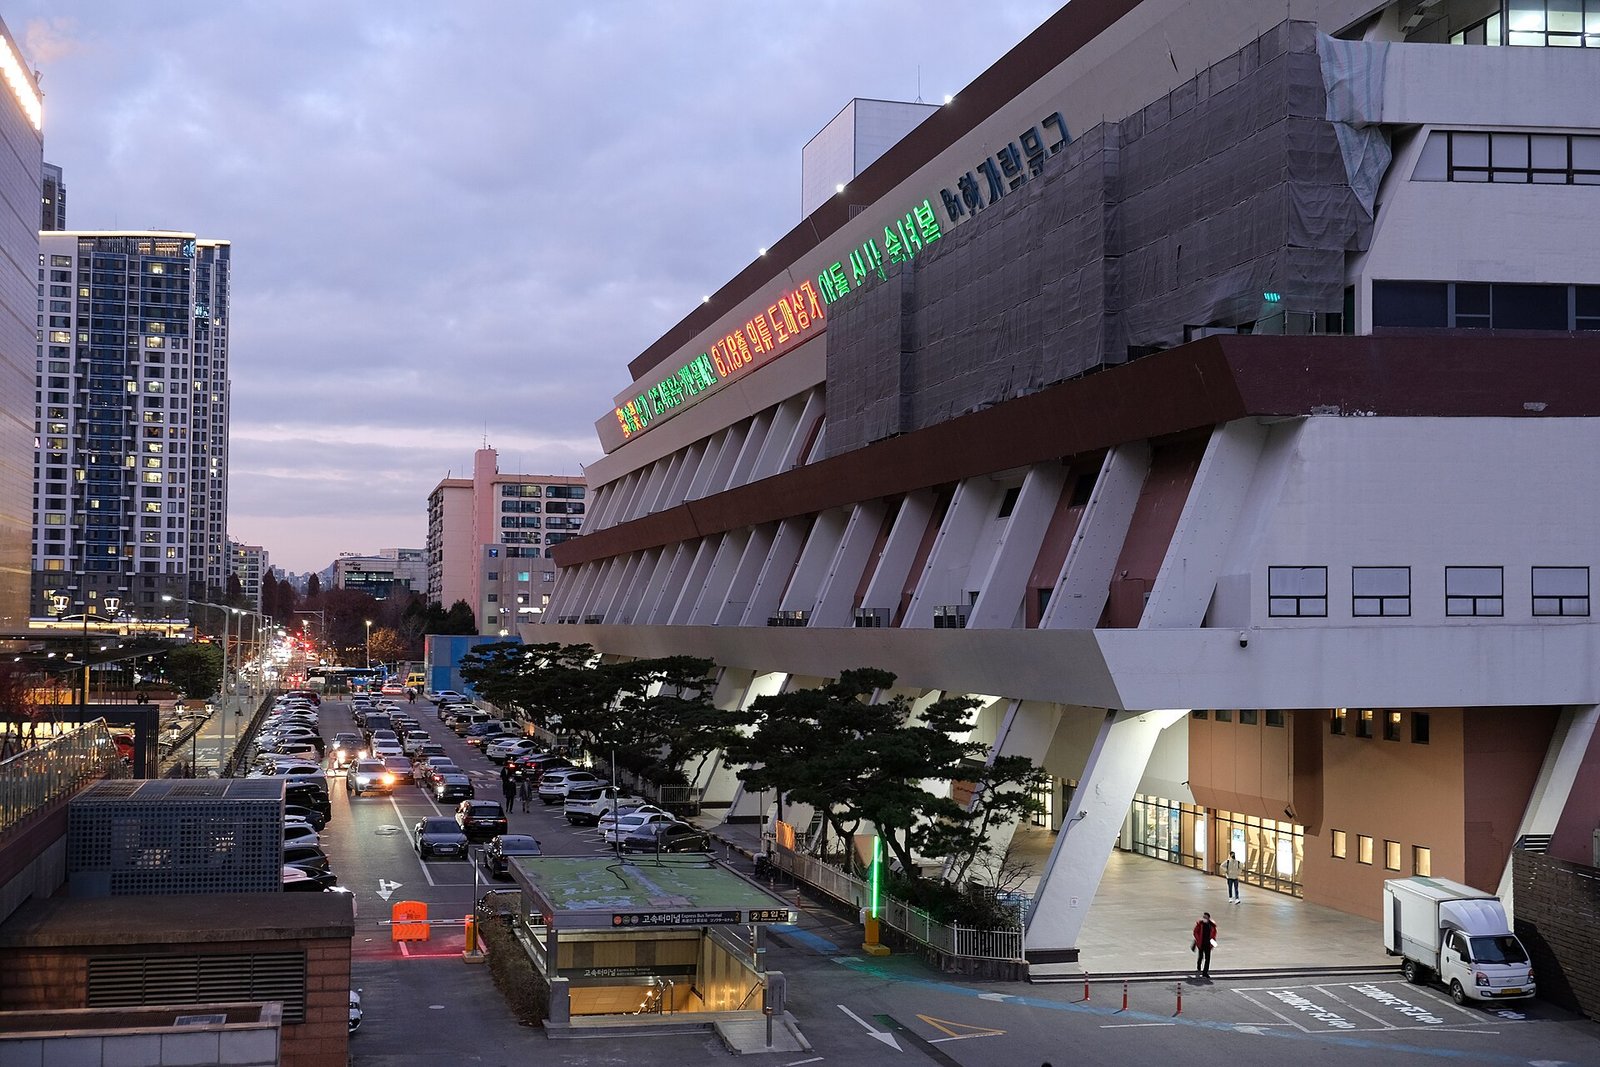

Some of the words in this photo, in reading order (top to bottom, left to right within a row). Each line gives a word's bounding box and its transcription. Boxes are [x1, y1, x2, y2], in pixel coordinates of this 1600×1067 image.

[746, 314, 775, 354] 의류
[818, 260, 851, 305] 아동
[642, 914, 681, 924] 고속터미널
[584, 969, 616, 977] 고속터미널
